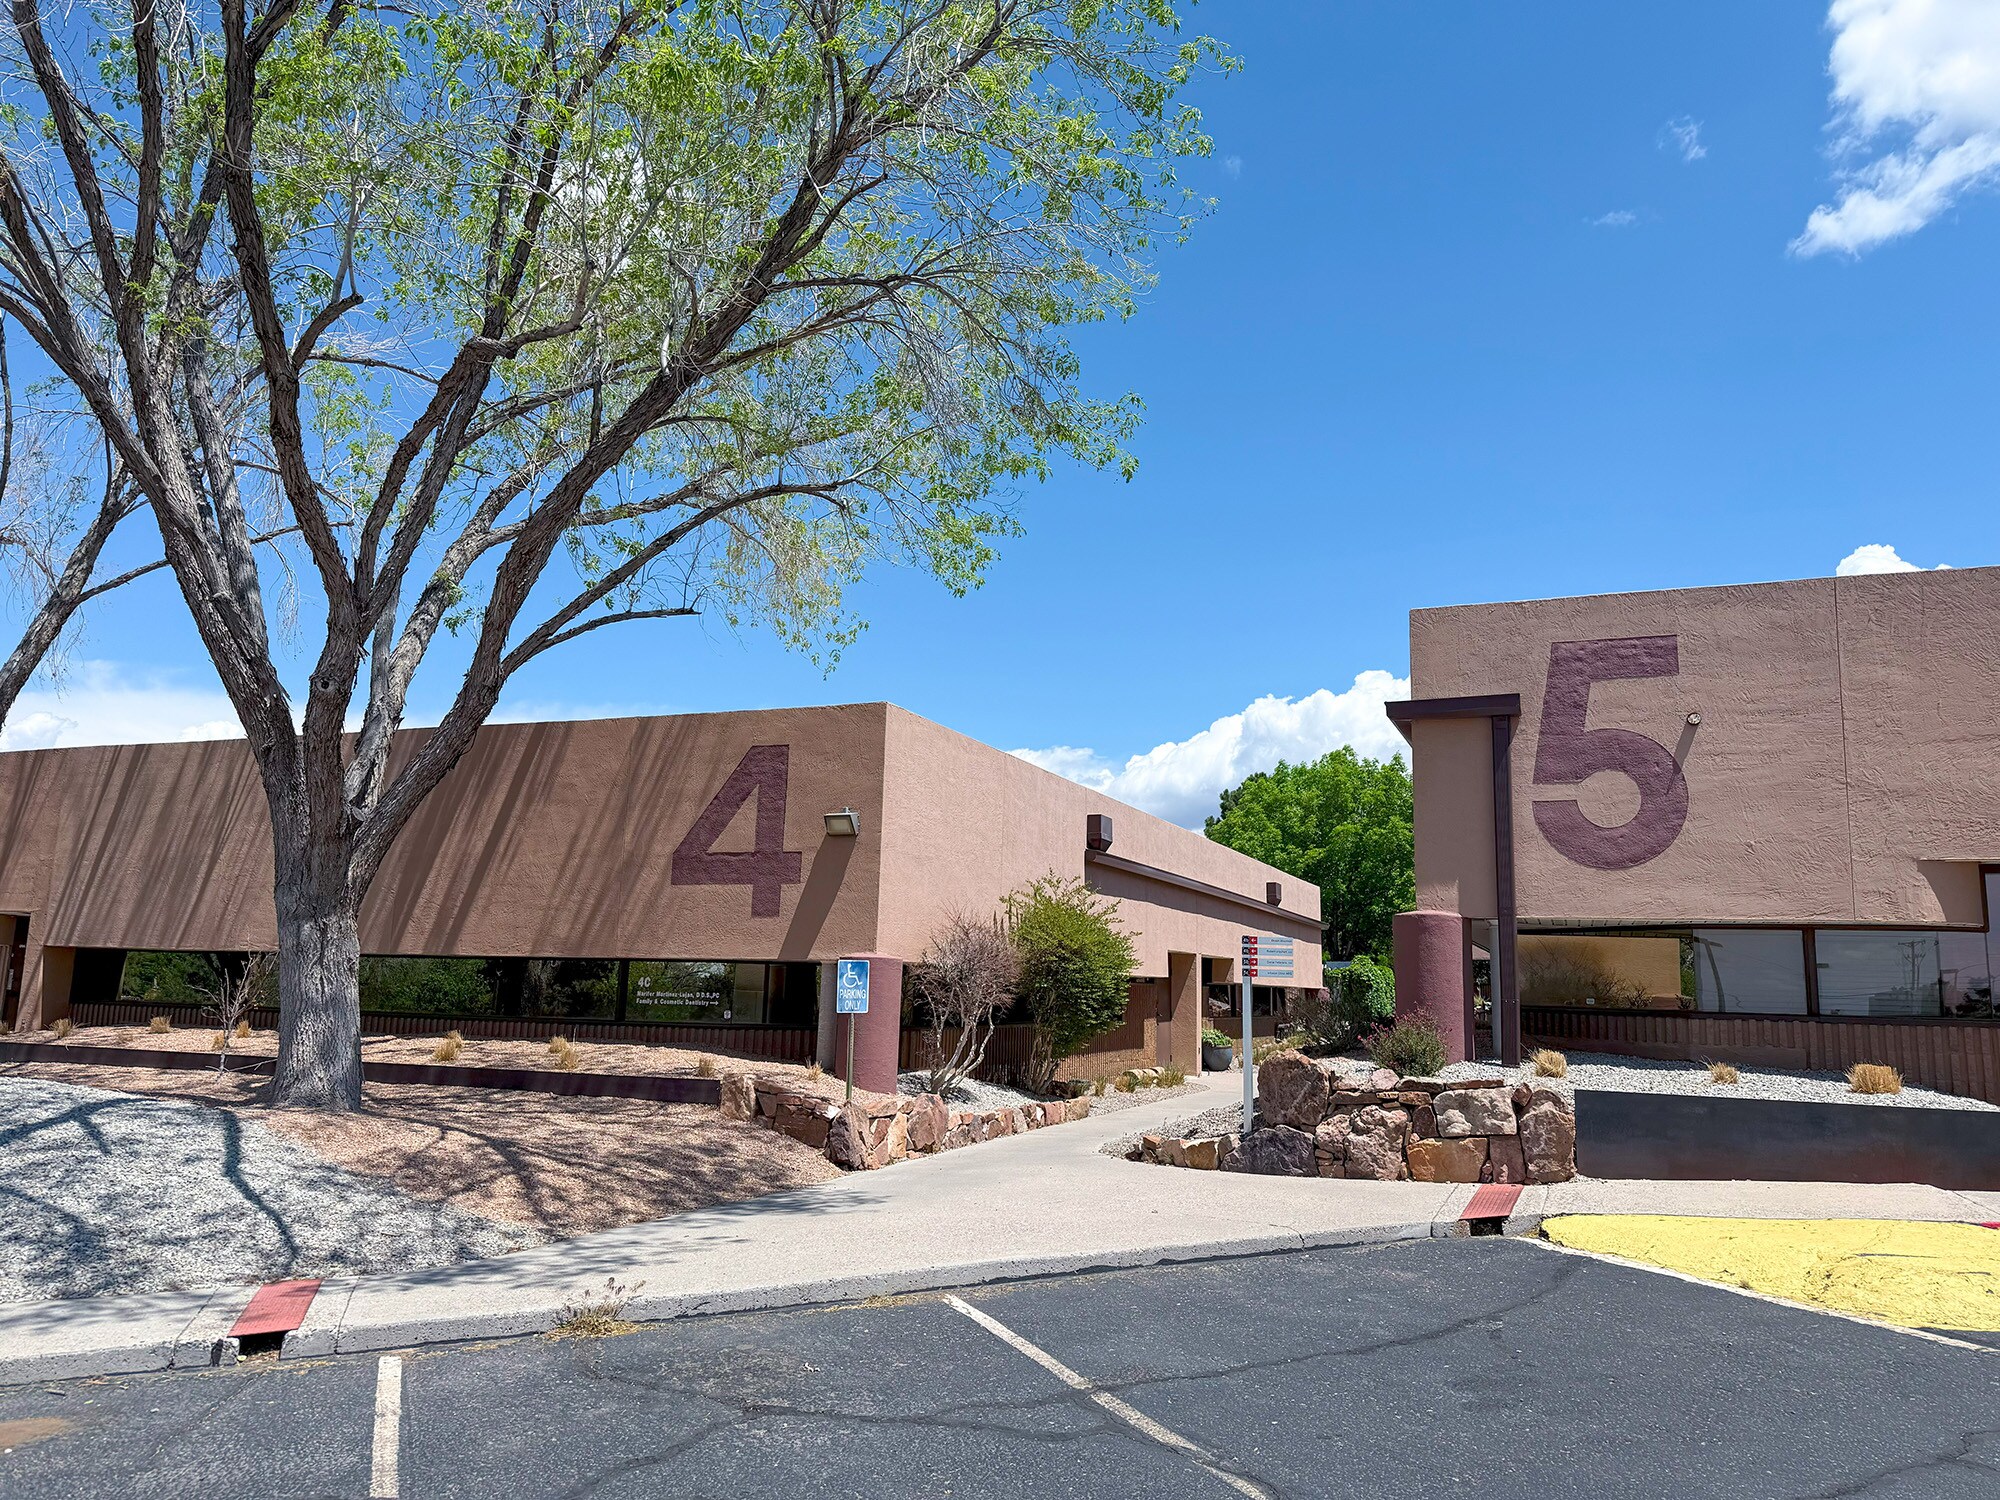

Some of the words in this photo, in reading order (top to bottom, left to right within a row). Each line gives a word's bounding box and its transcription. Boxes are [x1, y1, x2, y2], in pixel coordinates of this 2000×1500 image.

[1532, 634, 1689, 871] 5
[671, 745, 802, 918] 4
[638, 977, 651, 987] 4C
[840, 989, 866, 999] PARKING
[845, 1000, 861, 1010] ONLY
